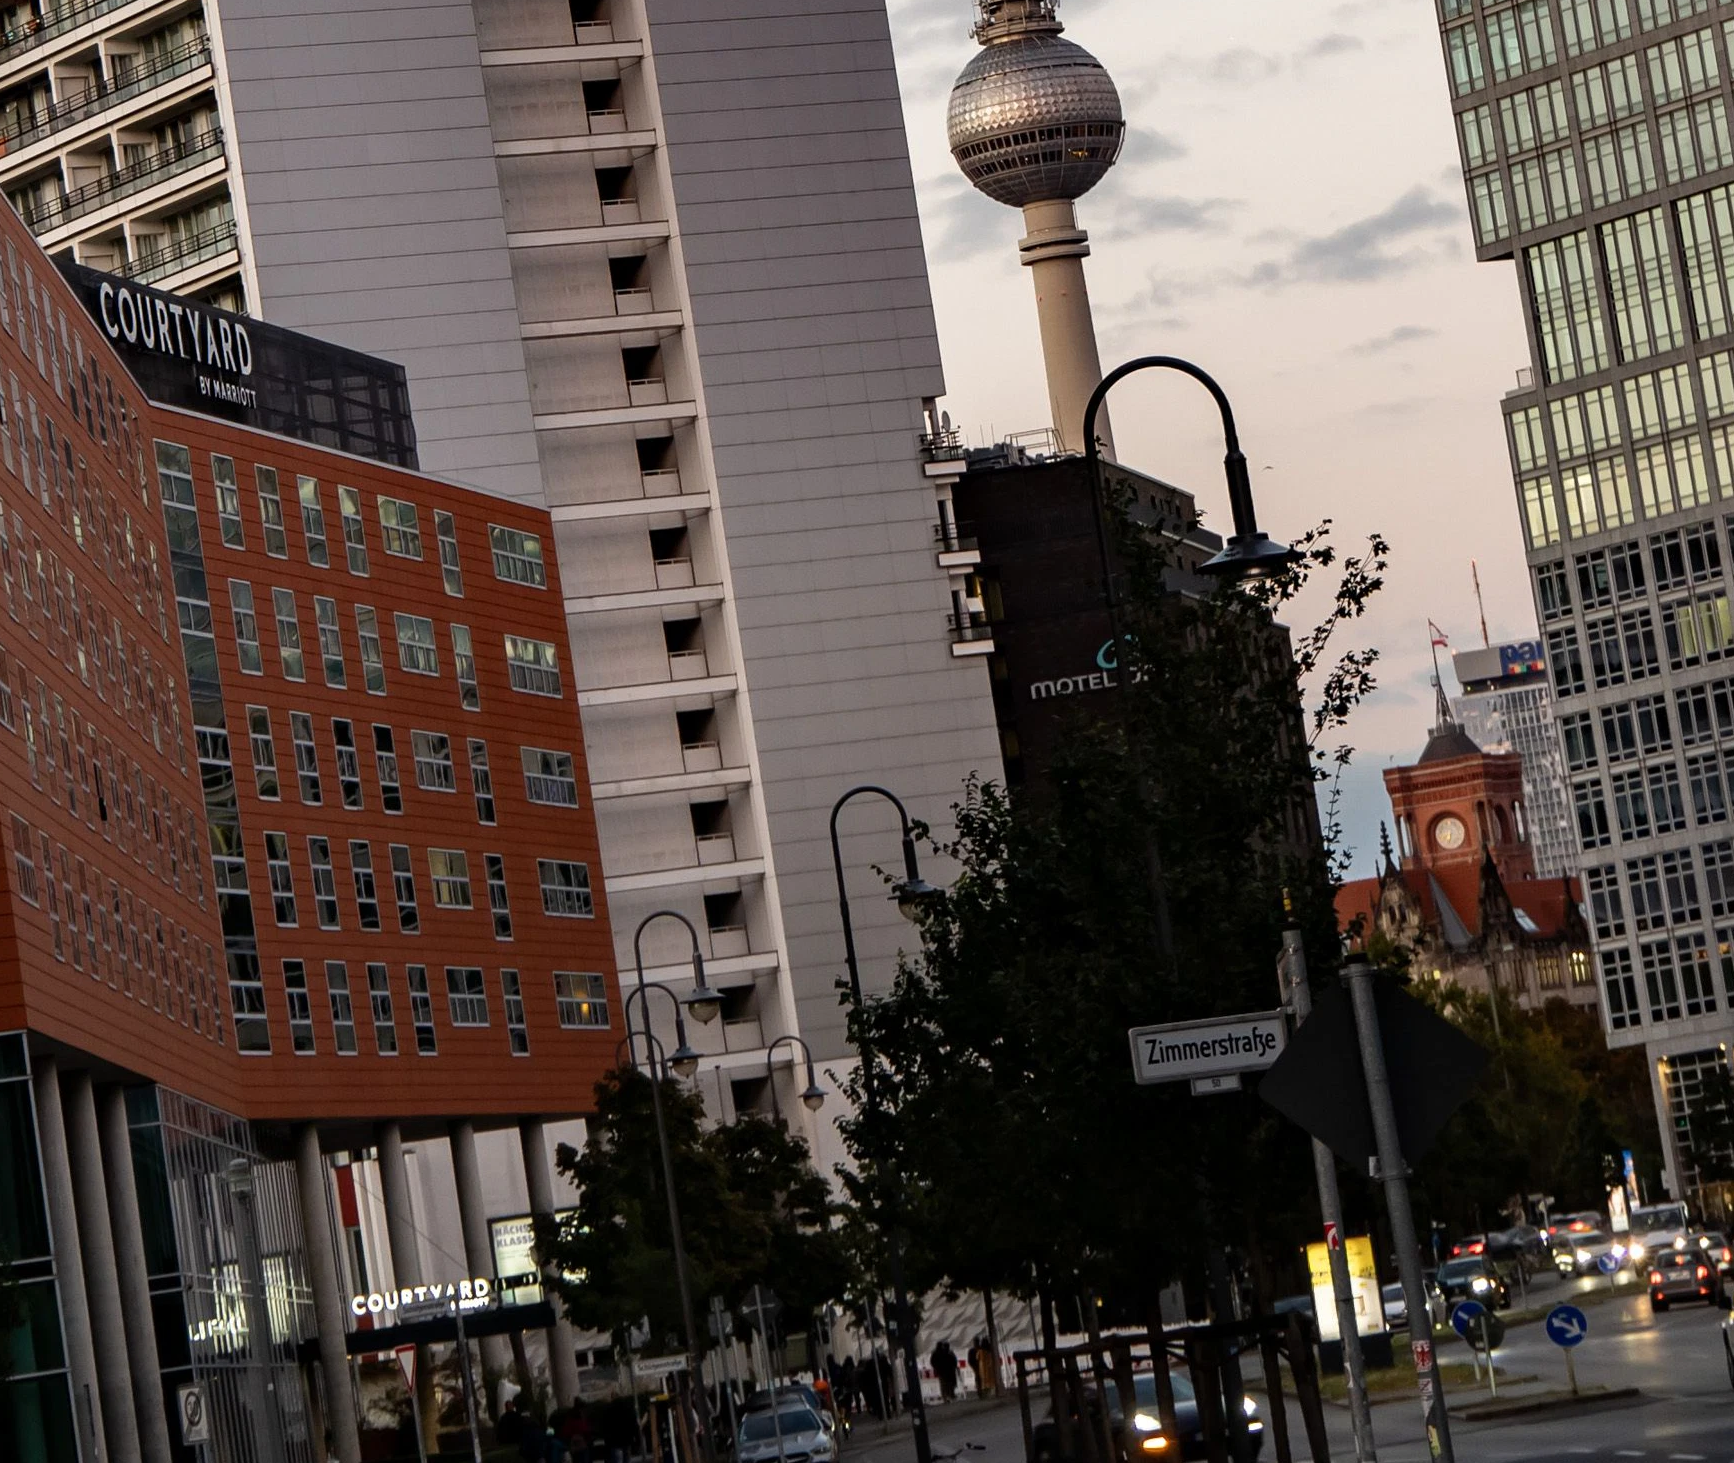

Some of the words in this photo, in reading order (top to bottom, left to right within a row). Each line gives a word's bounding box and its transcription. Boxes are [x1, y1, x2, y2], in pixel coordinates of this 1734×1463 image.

[100, 282, 252, 376] COURTYARD
[199, 376, 211, 396] BY
[213, 379, 257, 408] MARRIOTT
[1145, 1026, 1276, 1065] Zimmerstraße
[350, 1277, 490, 1316] COURTYARD
